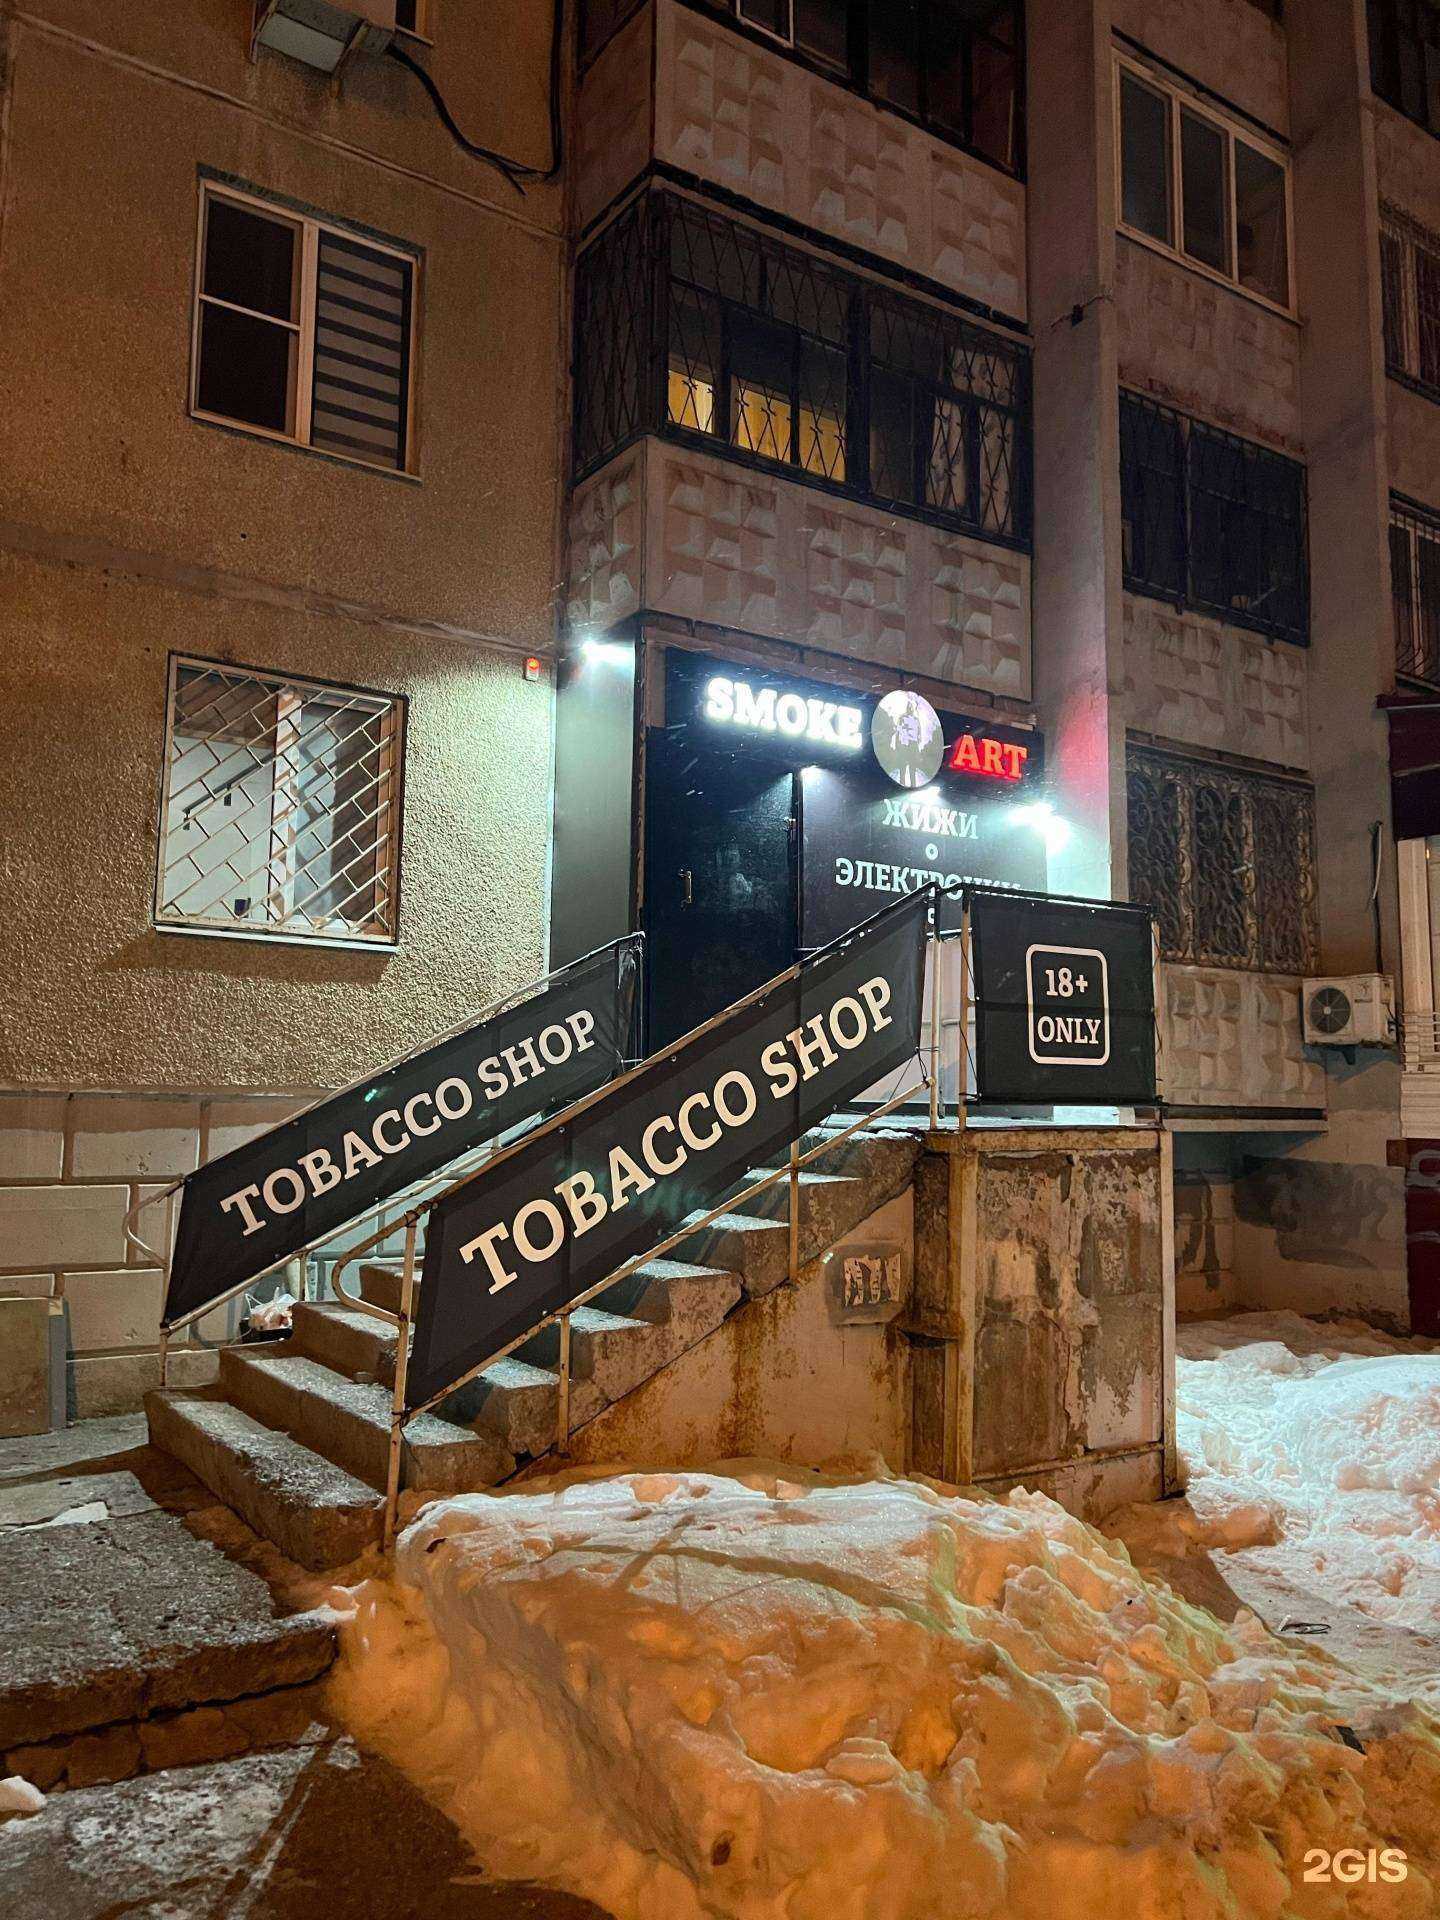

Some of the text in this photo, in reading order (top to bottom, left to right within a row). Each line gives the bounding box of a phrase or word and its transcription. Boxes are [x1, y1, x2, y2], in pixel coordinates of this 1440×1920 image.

[705, 676, 1028, 779] SMOKE ART
[882, 798, 979, 840] ЖИЖИ
[1045, 967, 1088, 997] 18+
[1037, 1015, 1101, 1044] ONLY
[220, 1009, 595, 1236] TOBACCO SHOP
[459, 976, 893, 1295] TOBACCO SHOP
